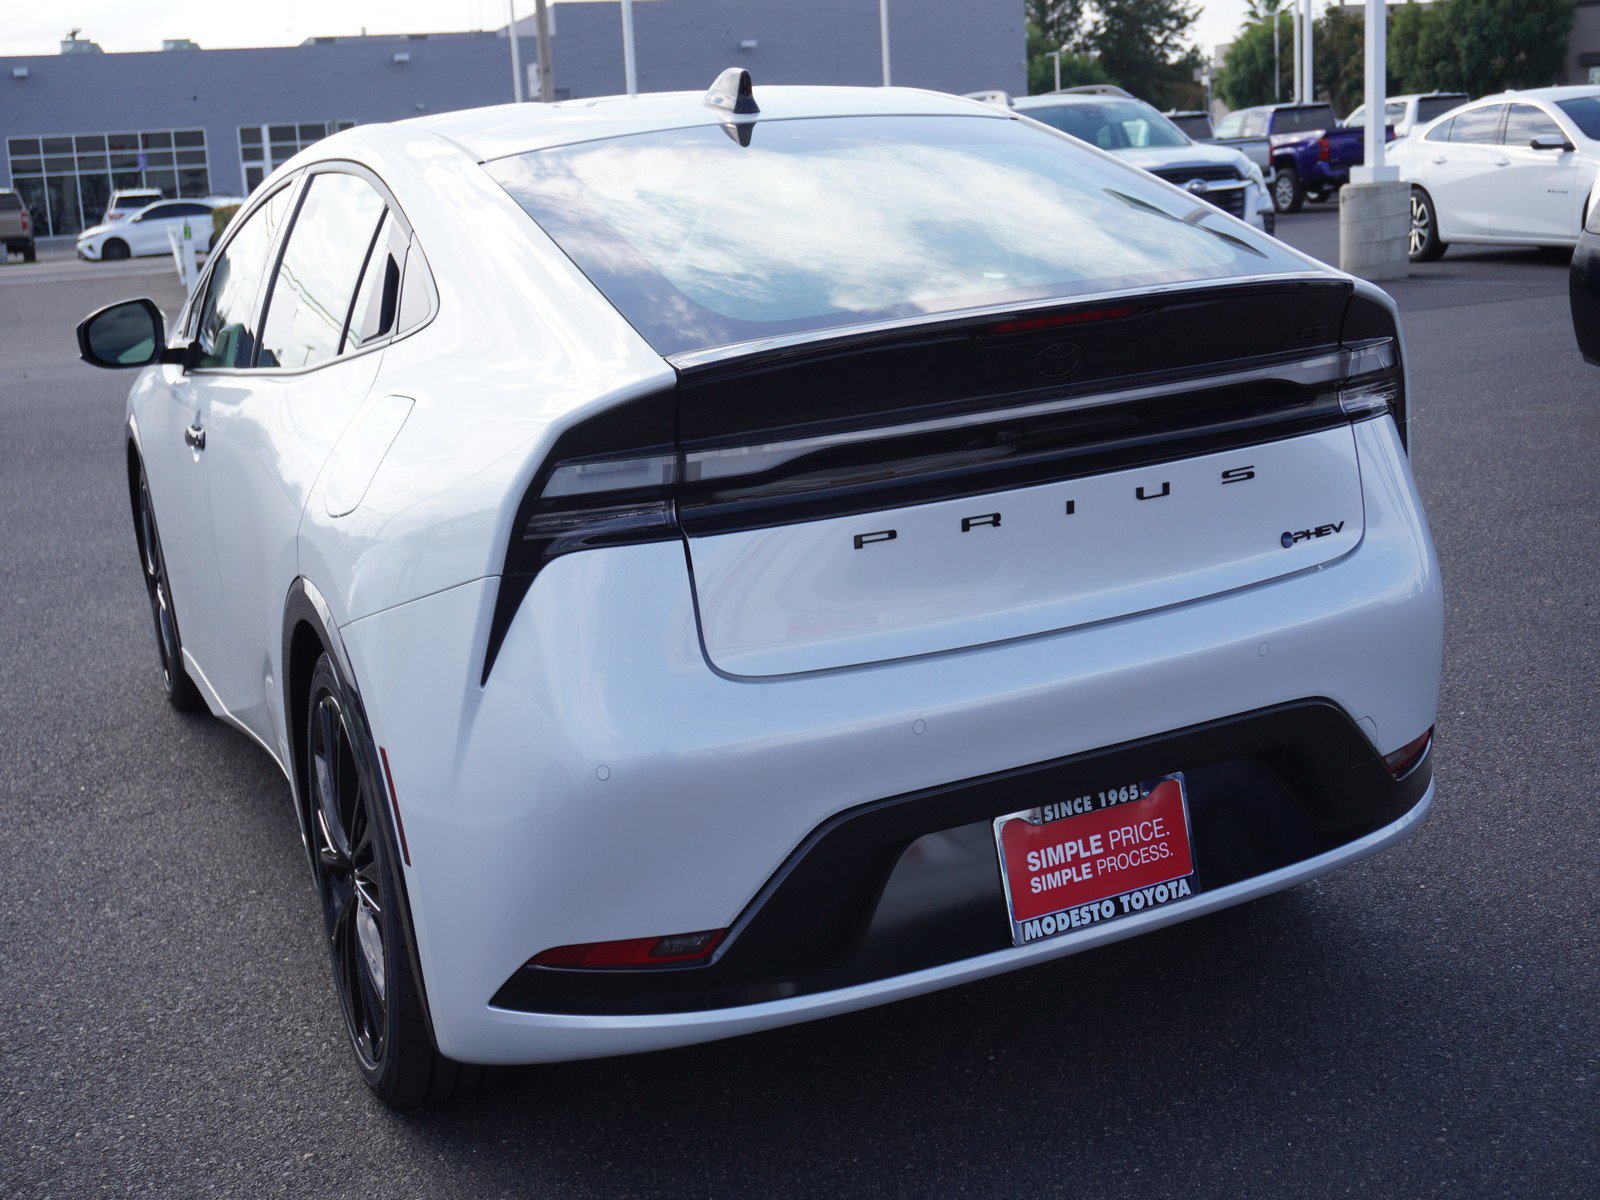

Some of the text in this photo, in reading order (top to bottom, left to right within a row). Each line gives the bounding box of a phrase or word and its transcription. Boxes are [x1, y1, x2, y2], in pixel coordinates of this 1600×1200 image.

[853, 465, 1255, 549] PRIUS
[1293, 521, 1345, 543] PHEV
[1044, 785, 1139, 821] SINCE 1965
[1026, 818, 1170, 872] SIMPLE PRICE.
[1030, 842, 1174, 894] SIMPLE PROCESS.
[1025, 878, 1191, 941] MODESTO TOYOTA
